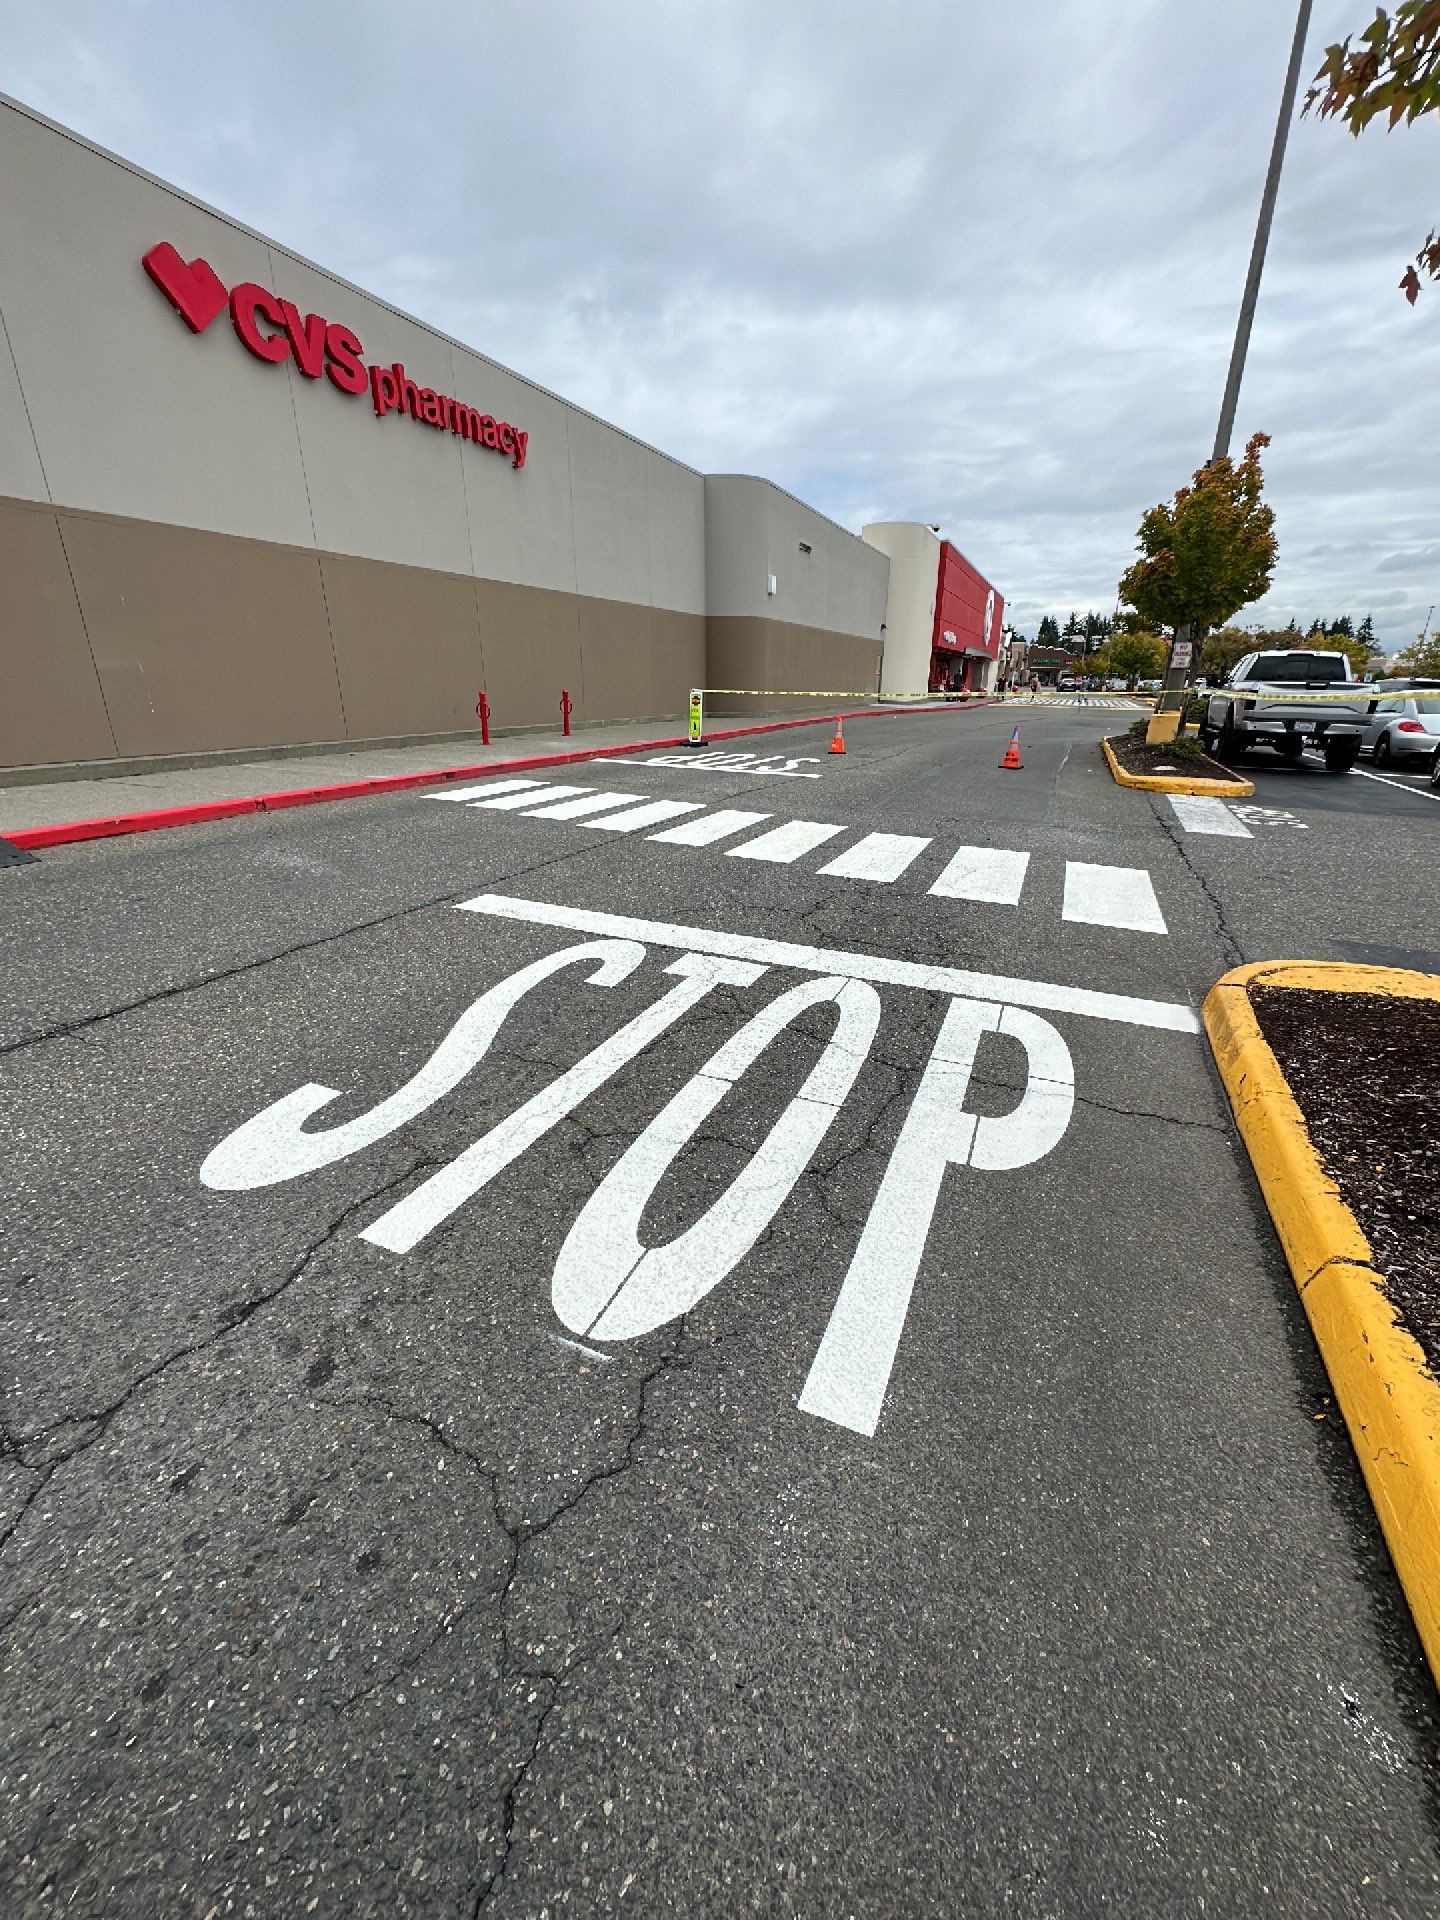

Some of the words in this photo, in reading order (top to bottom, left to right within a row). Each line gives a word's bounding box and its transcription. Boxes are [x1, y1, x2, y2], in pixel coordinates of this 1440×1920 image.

[229, 282, 368, 395] CVS
[369, 363, 529, 469] pharmacy
[648, 752, 820, 772] STOP
[200, 938, 1076, 1436] STOP
